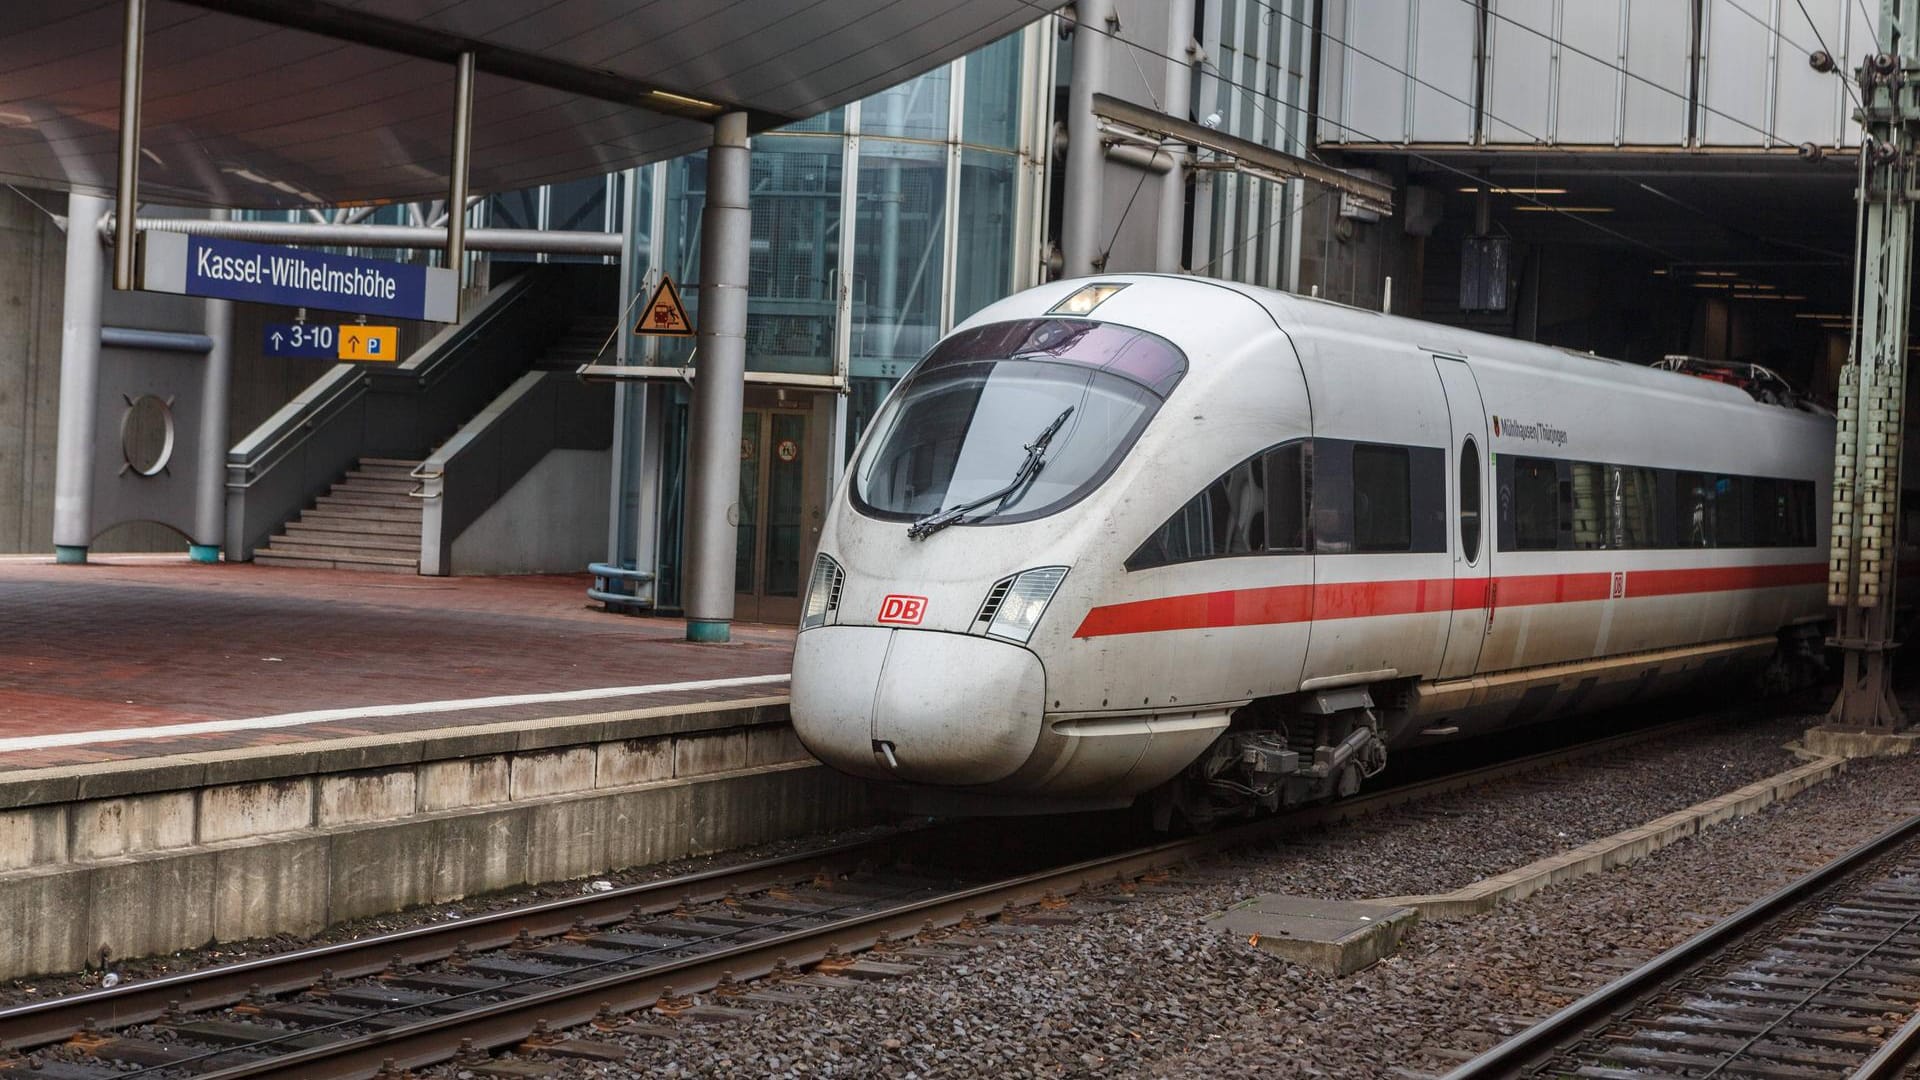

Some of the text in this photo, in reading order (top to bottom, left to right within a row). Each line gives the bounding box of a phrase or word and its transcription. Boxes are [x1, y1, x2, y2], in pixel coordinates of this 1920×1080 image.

[197, 246, 396, 298] Kassel-Wilhelmshöhe
[290, 325, 332, 348] 3-10
[368, 338, 378, 354] P
[1615, 471, 1621, 500] 2
[1614, 574, 1623, 596] DB
[884, 599, 921, 619] DB
